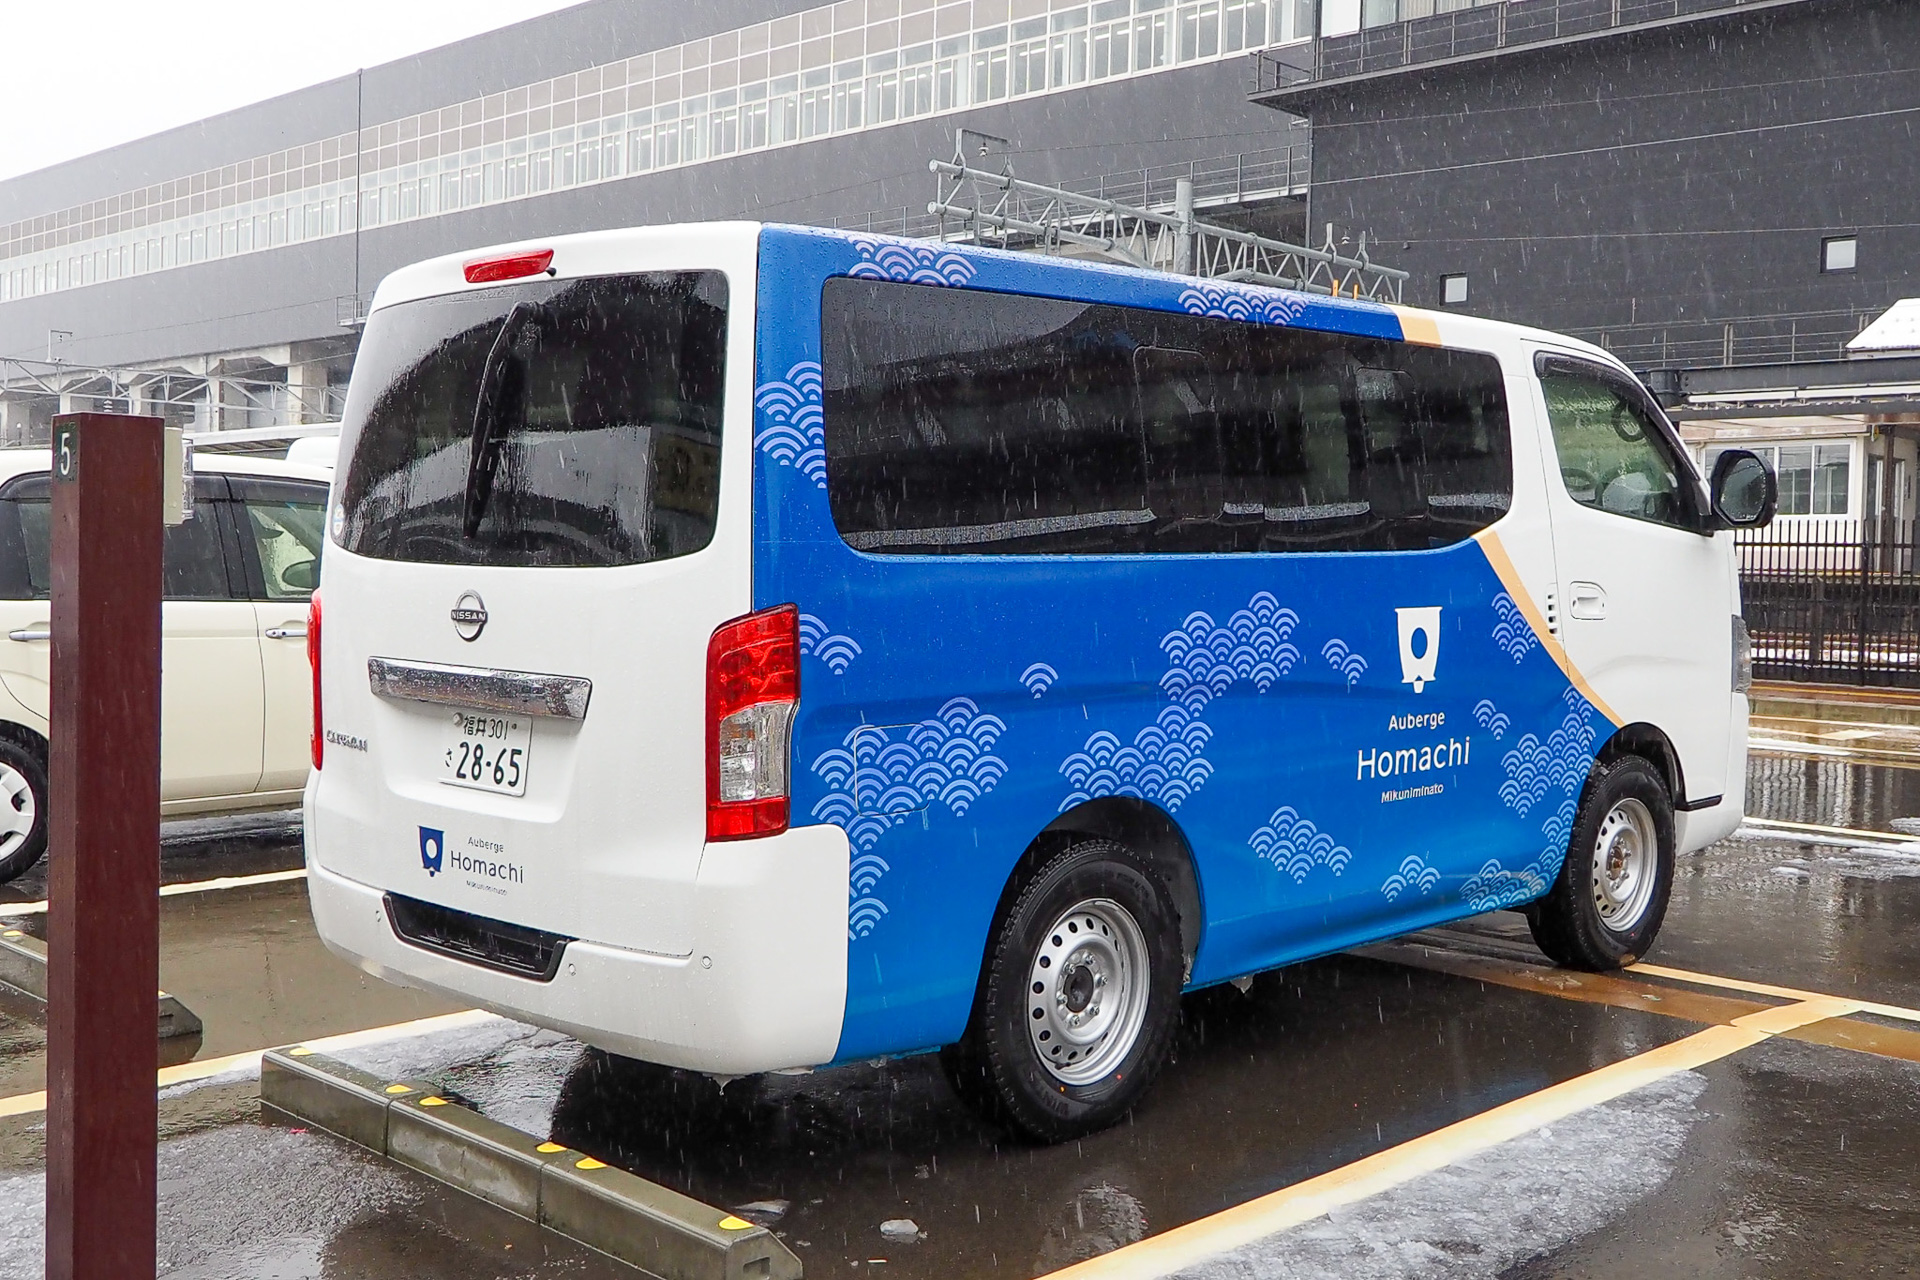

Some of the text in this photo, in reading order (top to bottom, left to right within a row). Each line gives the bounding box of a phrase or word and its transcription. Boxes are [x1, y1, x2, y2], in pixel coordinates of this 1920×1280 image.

[60, 433, 71, 476] 5
[451, 611, 487, 621] NISSAN
[1388, 712, 1446, 732] Auberge
[1356, 736, 1471, 781] Homachi
[1380, 783, 1445, 804] Mikuniminato
[467, 836, 504, 854] Auberge
[450, 850, 523, 884] Homachi
